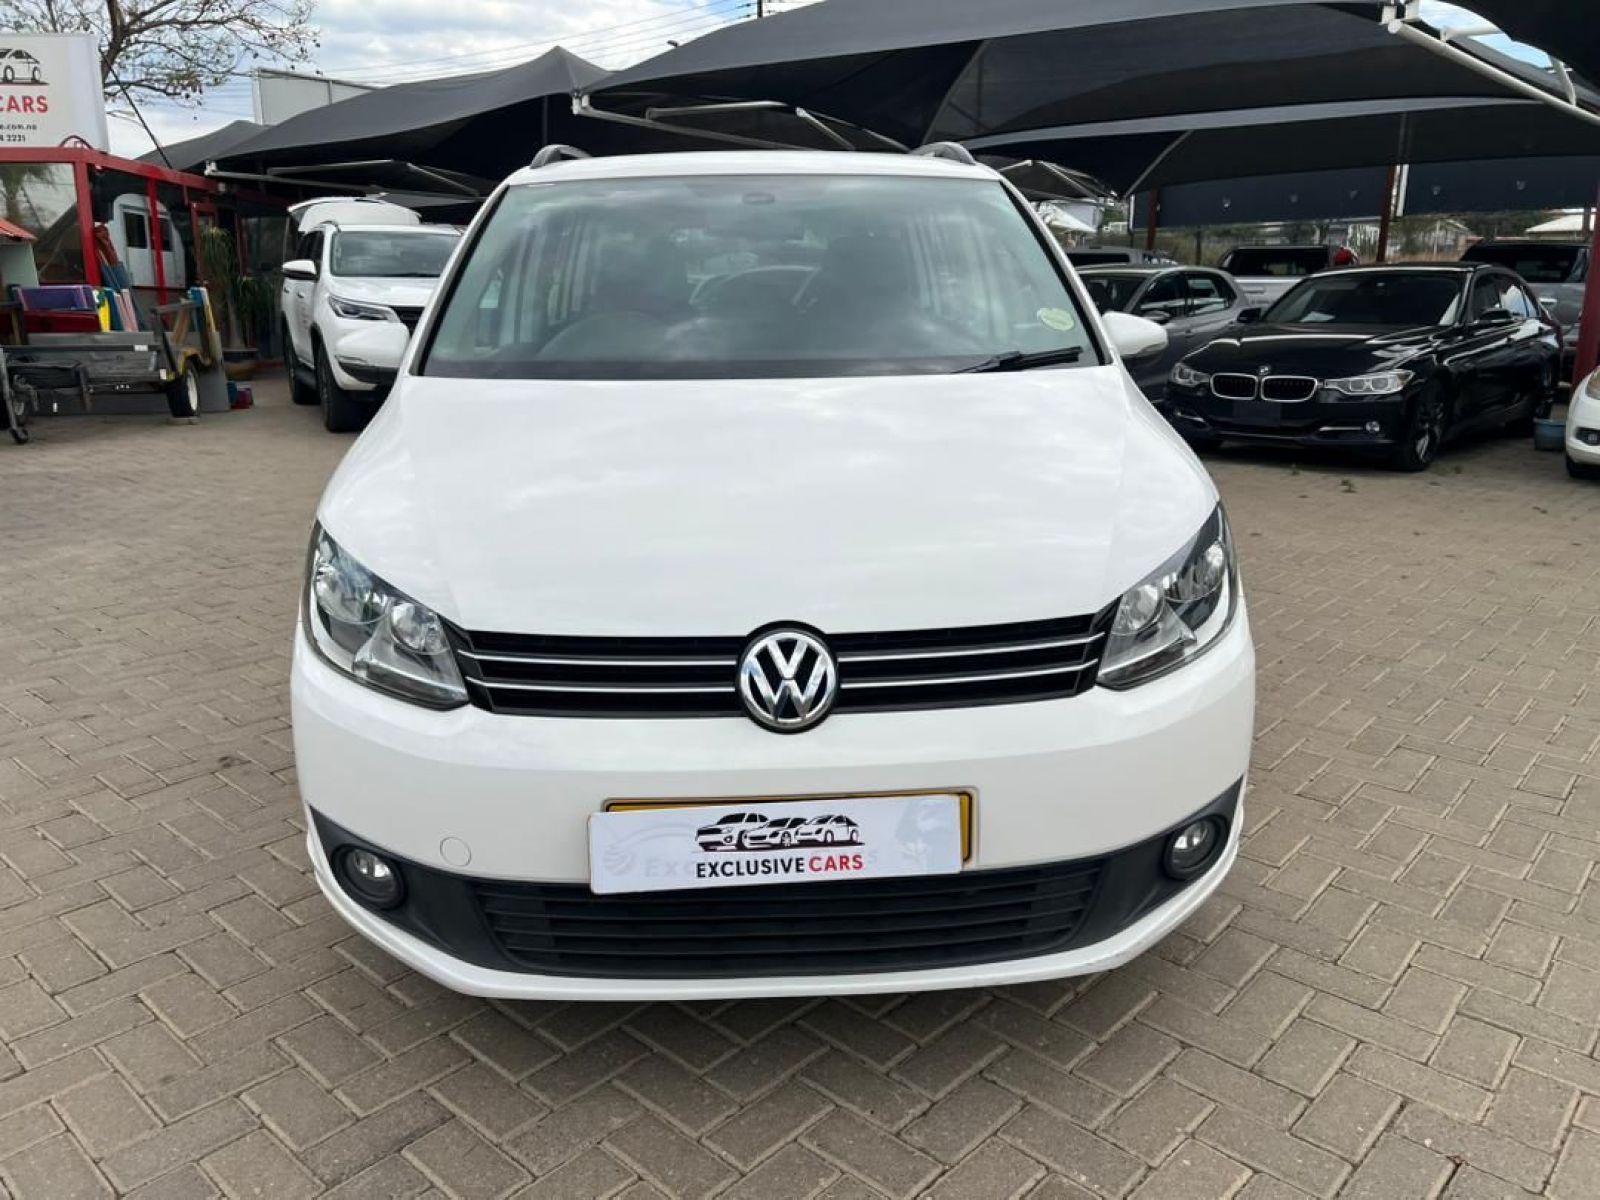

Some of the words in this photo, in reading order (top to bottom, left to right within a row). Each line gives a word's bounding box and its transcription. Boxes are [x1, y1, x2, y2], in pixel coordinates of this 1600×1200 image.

[741, 632, 836, 727] VW
[696, 857, 805, 879] EXCLUSIVE
[808, 854, 864, 873] CARS
